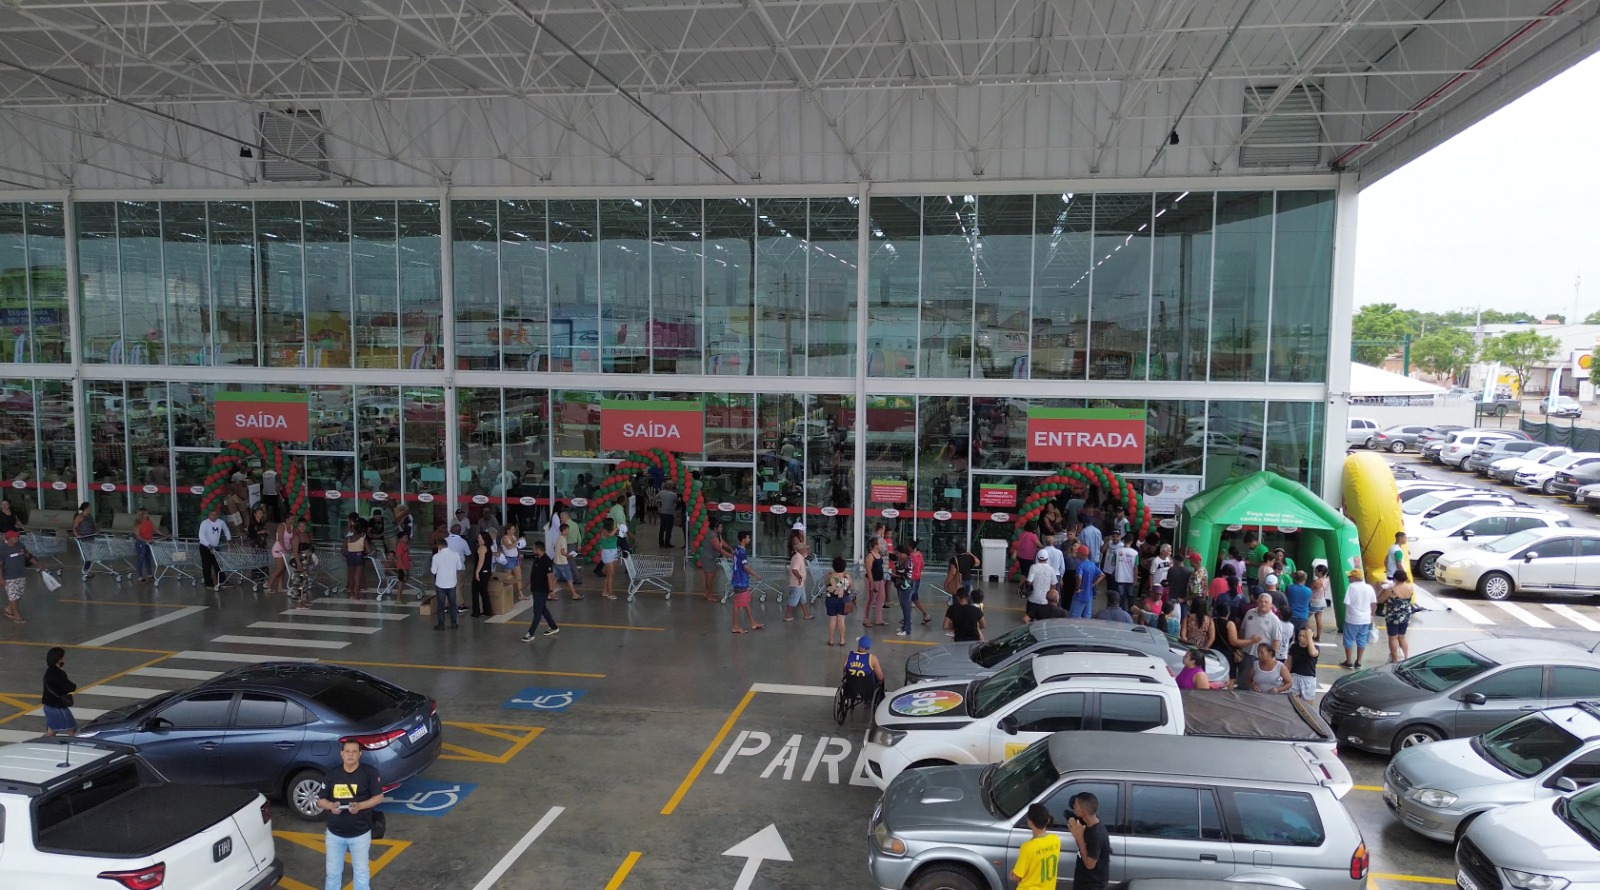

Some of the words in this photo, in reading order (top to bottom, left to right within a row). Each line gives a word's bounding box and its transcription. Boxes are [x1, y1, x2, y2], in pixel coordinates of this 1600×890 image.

[235, 411, 288, 428] SAÍDA
[623, 420, 681, 438] SAÍDA
[1034, 431, 1138, 448] ENTRADA
[850, 661, 865, 669] CURRY
[218, 839, 231, 857] FIAT
[1040, 854, 1057, 884] 10
